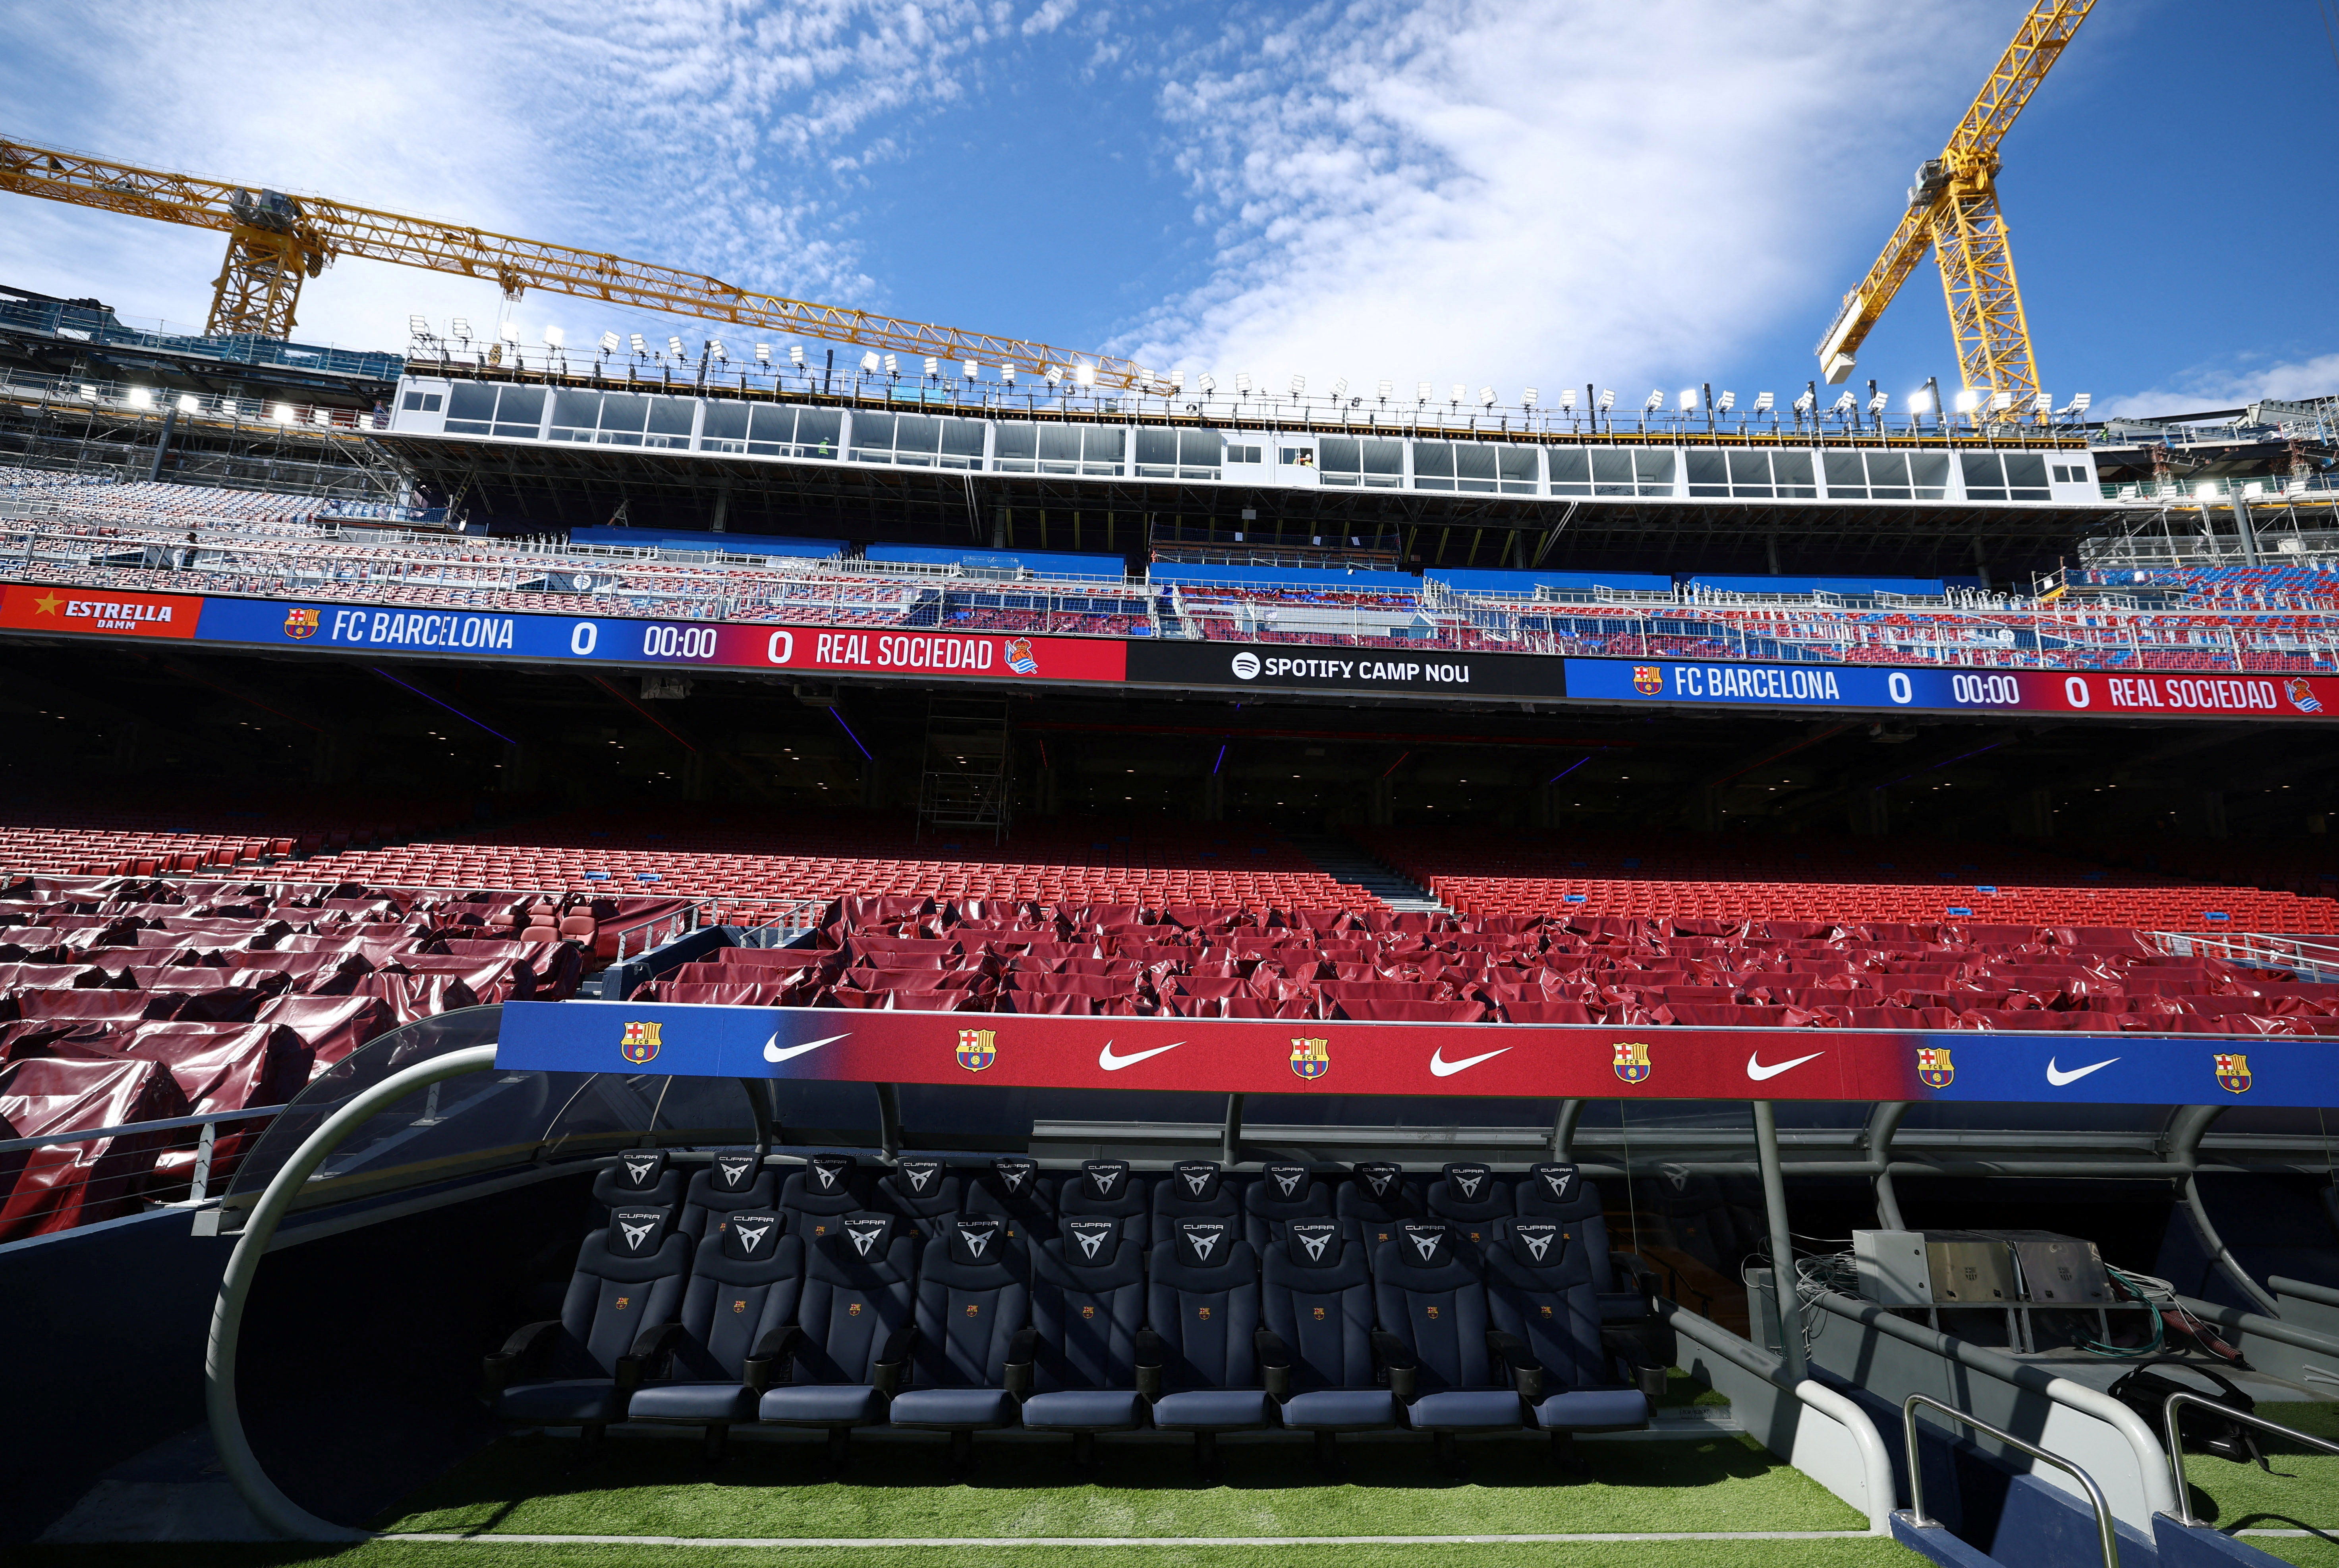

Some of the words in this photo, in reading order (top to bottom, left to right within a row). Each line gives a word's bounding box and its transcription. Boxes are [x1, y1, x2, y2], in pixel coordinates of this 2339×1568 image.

[64, 600, 172, 623] ESTRELLA
[96, 619, 136, 630] DAMM
[332, 611, 366, 641] FC
[370, 613, 513, 648] BARCELONA
[572, 623, 597, 655] 0
[644, 626, 717, 658] 00:00
[768, 631, 793, 663] 0
[817, 634, 871, 664] REAL
[878, 636, 992, 669] SOCIEDAD
[1266, 658, 1353, 678] SPOTIFY
[1360, 662, 1419, 680] CAMP
[1426, 664, 1468, 682] NOU
[1675, 667, 1702, 695] FC
[1708, 668, 1839, 699] BARCELONA
[1889, 673, 1912, 703] 0
[1953, 675, 2019, 704] 00:00
[2065, 677, 2089, 708] 0
[2109, 679, 2164, 706] REAL
[2166, 680, 2277, 708] SOCIEDAD
